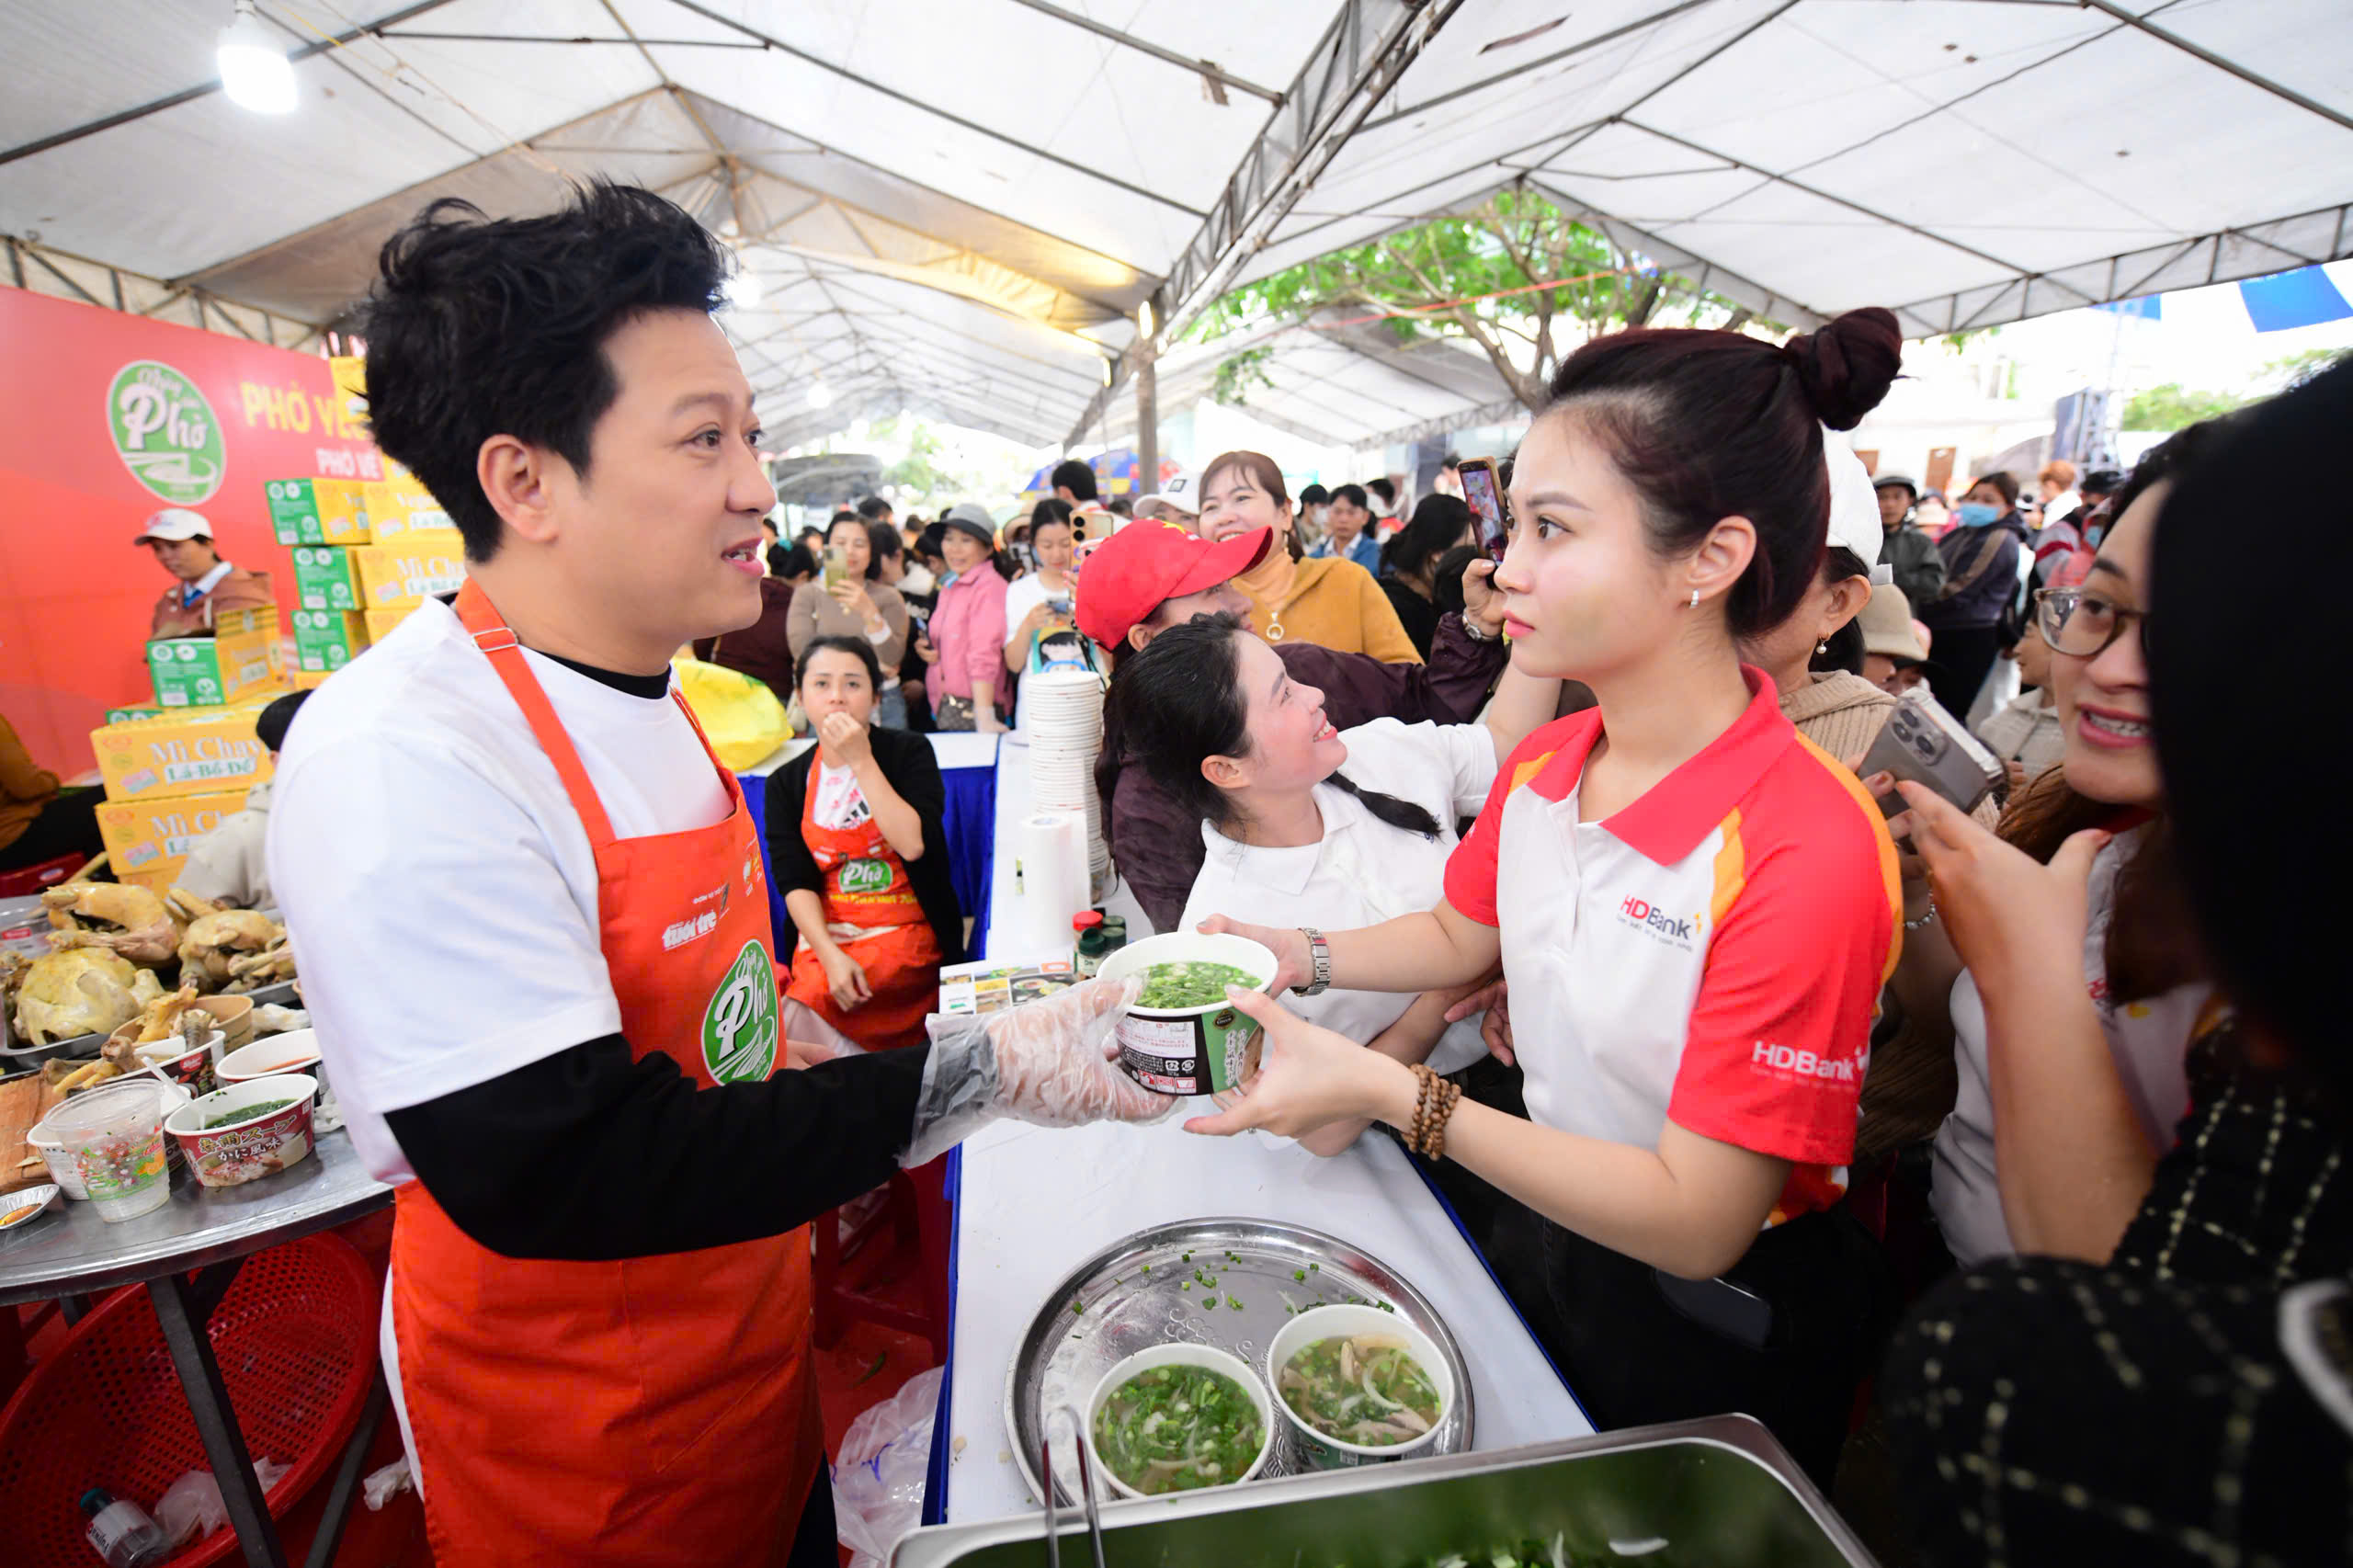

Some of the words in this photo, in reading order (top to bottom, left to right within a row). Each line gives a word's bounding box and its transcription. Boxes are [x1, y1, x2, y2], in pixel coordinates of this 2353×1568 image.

[426, 556, 463, 576] Cha
[149, 739, 188, 765] Mì
[195, 736, 261, 759] Chay
[151, 812, 189, 838] Mì
[1620, 894, 1691, 940] HDBank
[1752, 1040, 1854, 1081] HDBank
[198, 1114, 297, 1154] 春雨スープ
[218, 1136, 281, 1161] かに風味
